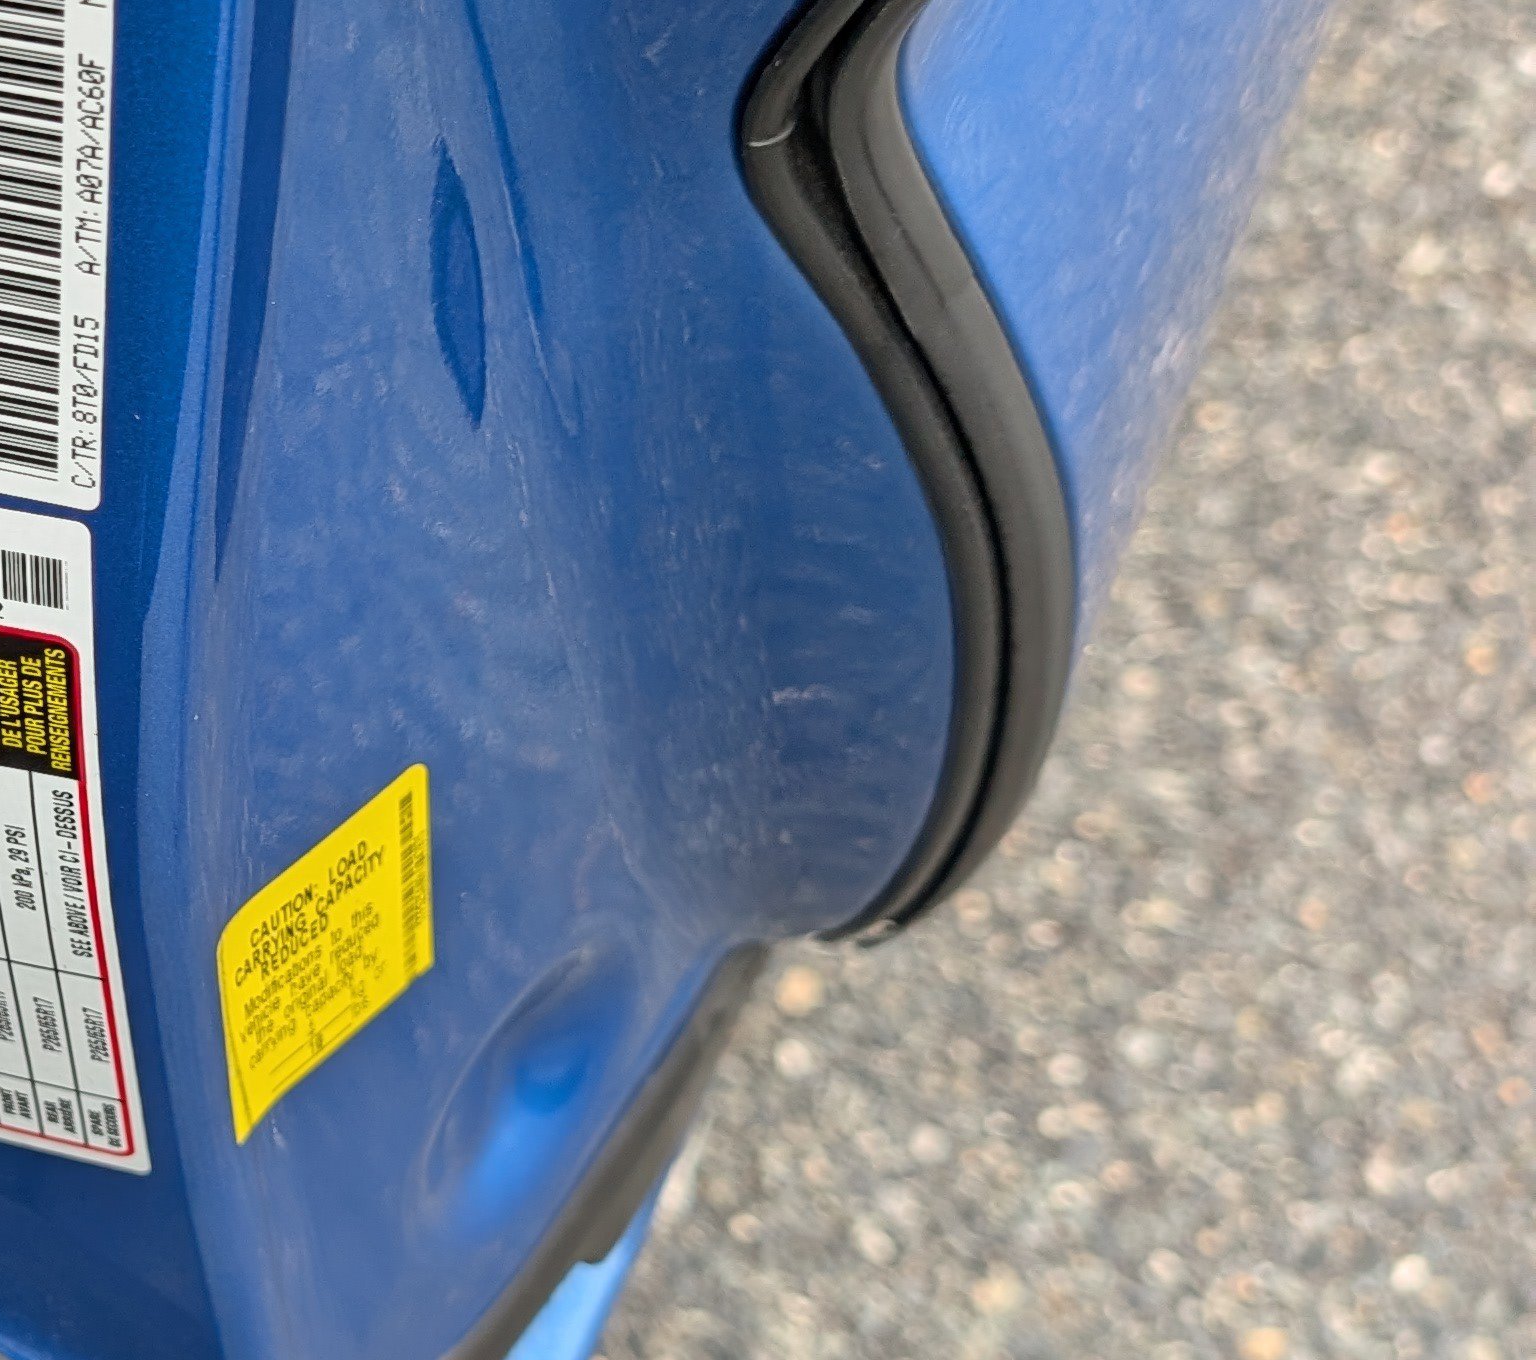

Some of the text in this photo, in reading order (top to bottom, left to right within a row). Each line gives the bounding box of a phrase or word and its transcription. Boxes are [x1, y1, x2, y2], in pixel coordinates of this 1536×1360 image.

[0, 728, 23, 748] DE
[20, 655, 48, 755] POUR PLUS DE
[43, 648, 72, 772] RENSEIGNEMENTS
[4, 824, 37, 911] 200 kPa, 29 PSI
[59, 865, 94, 958] SEE ABOVE VOIR
[250, 883, 318, 948] CAUTION:
[328, 840, 368, 886] LOAD
[234, 912, 308, 987] CARRYING
[316, 845, 386, 916] CAPACITY
[260, 913, 329, 982] REDUCED
